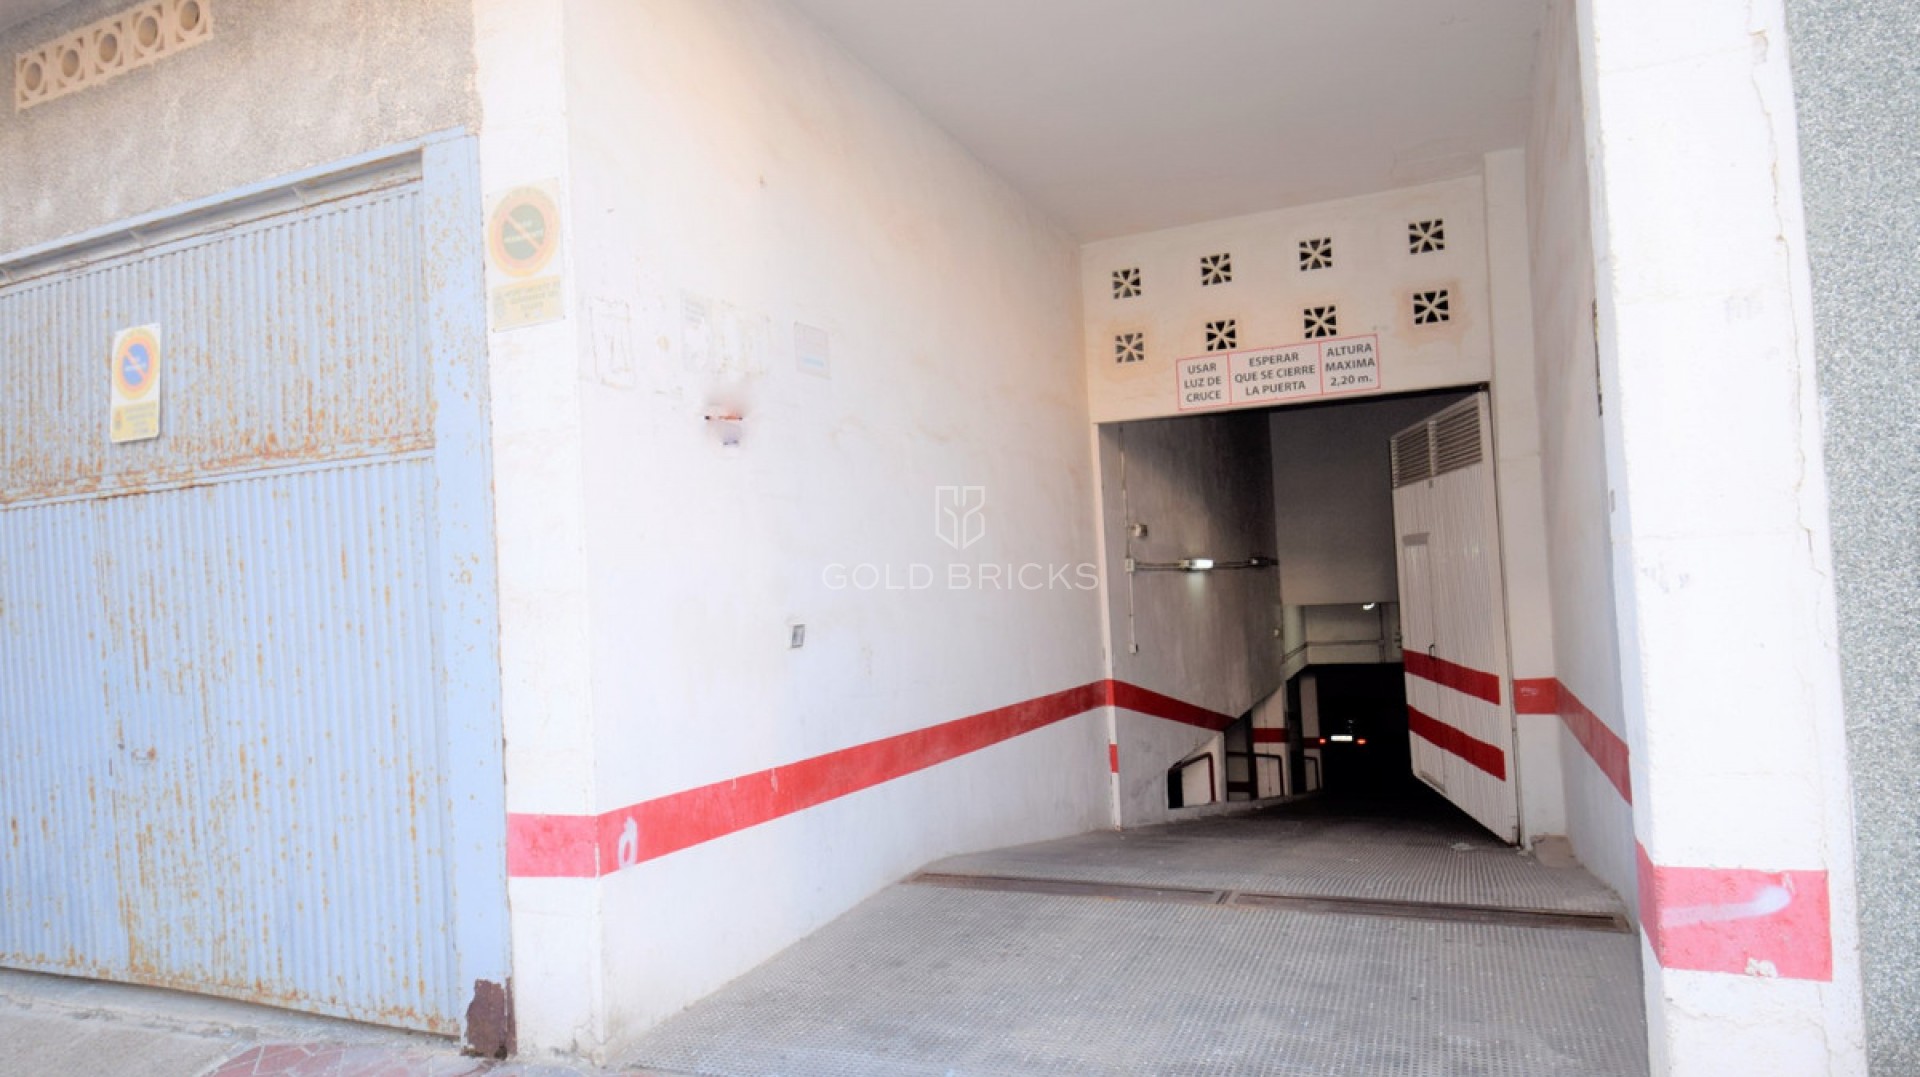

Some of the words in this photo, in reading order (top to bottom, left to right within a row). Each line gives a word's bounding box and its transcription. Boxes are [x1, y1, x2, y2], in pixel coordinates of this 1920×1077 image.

[1326, 343, 1372, 357] ALTURA
[1249, 352, 1299, 367] ESPERAR
[1325, 357, 1375, 372] MAXIMA
[1187, 363, 1217, 374] USAR
[1235, 371, 1258, 384] QUE
[1261, 370, 1274, 381] SE
[1276, 365, 1315, 379] CIERRE
[1184, 378, 1205, 389] LUZ
[1207, 376, 1221, 387] DE
[1330, 375, 1355, 388] 2,20
[1358, 374, 1372, 383] m.
[1245, 386, 1260, 397] LA
[1262, 381, 1306, 394] PUERTA
[1186, 390, 1222, 403] CRUCE
